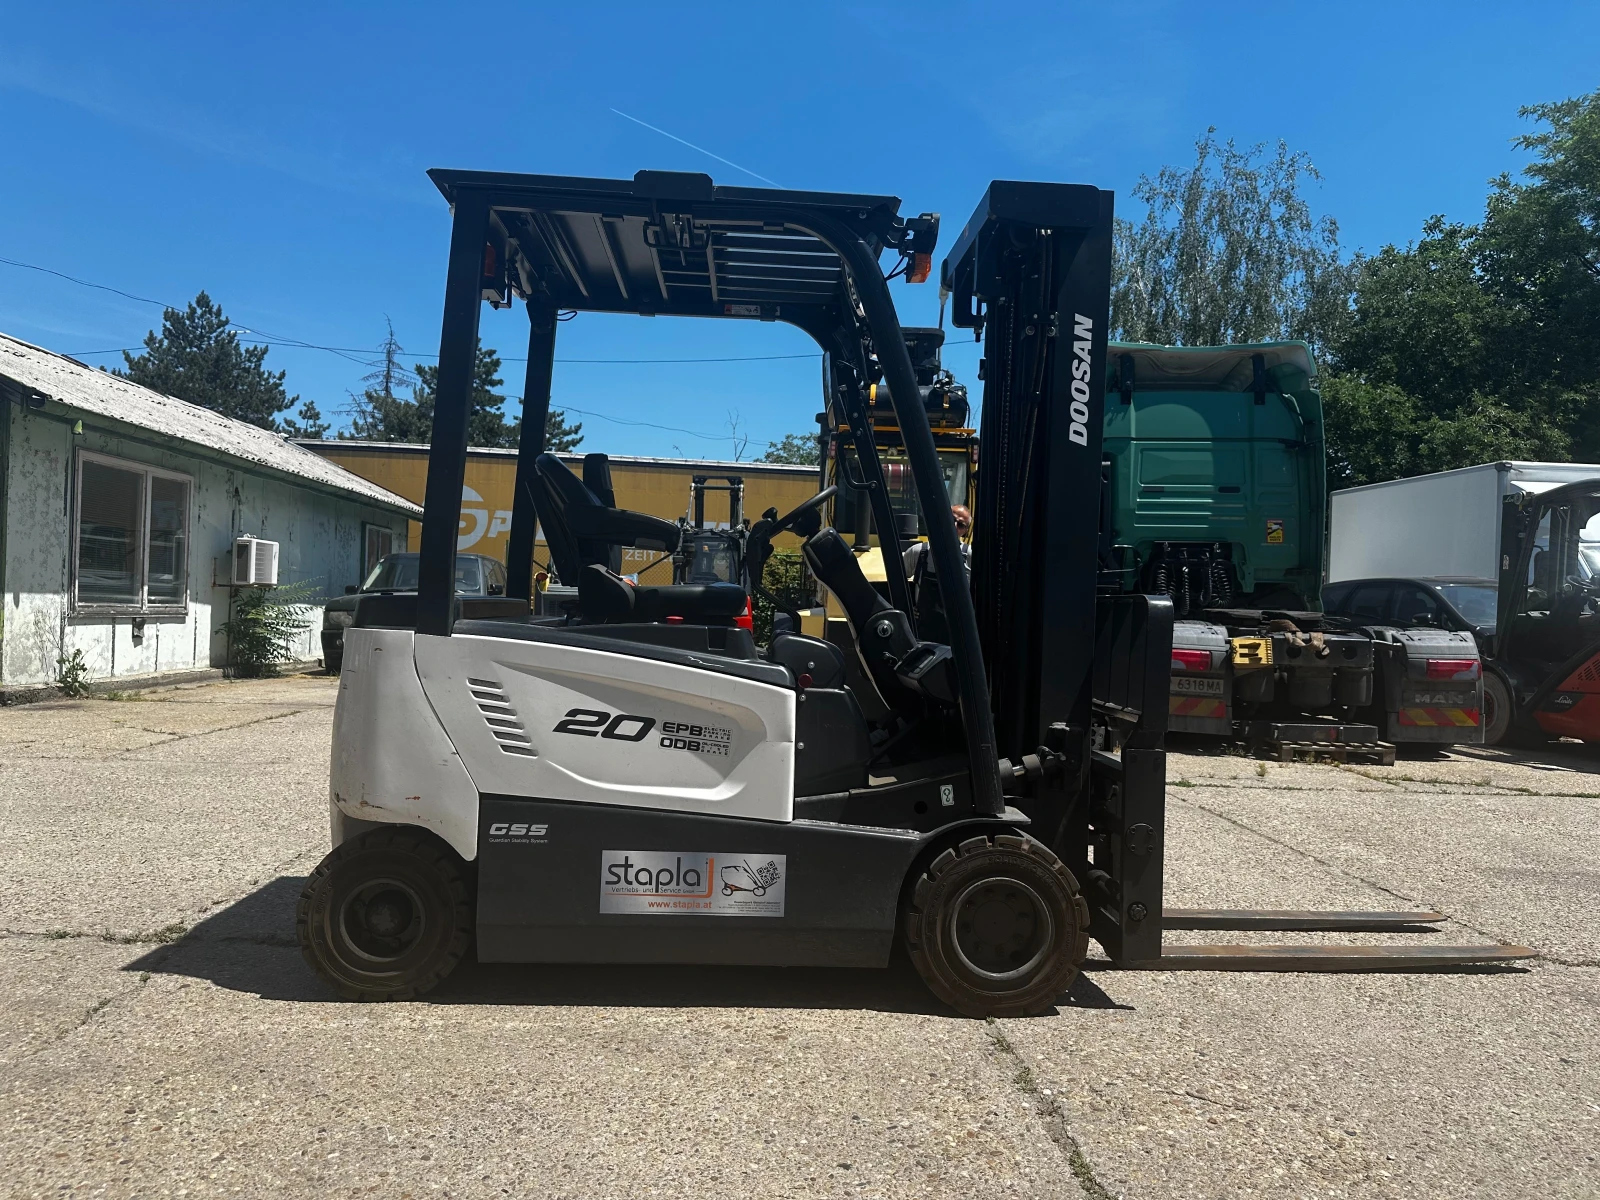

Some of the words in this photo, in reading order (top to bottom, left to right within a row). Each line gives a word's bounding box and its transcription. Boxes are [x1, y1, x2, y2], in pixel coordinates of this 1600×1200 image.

[1069, 313, 1093, 446] DOOSAN
[625, 550, 655, 561] ZEIT
[1415, 693, 1464, 704] MAN
[1554, 695, 1573, 705] Linde
[552, 708, 656, 742] 20
[662, 721, 703, 736] EPB
[704, 726, 731, 734] ELECTRIC
[660, 737, 701, 752] ODB
[489, 823, 549, 836] GSS
[605, 856, 701, 893] stapla
[647, 900, 712, 910] www.stapla.at
